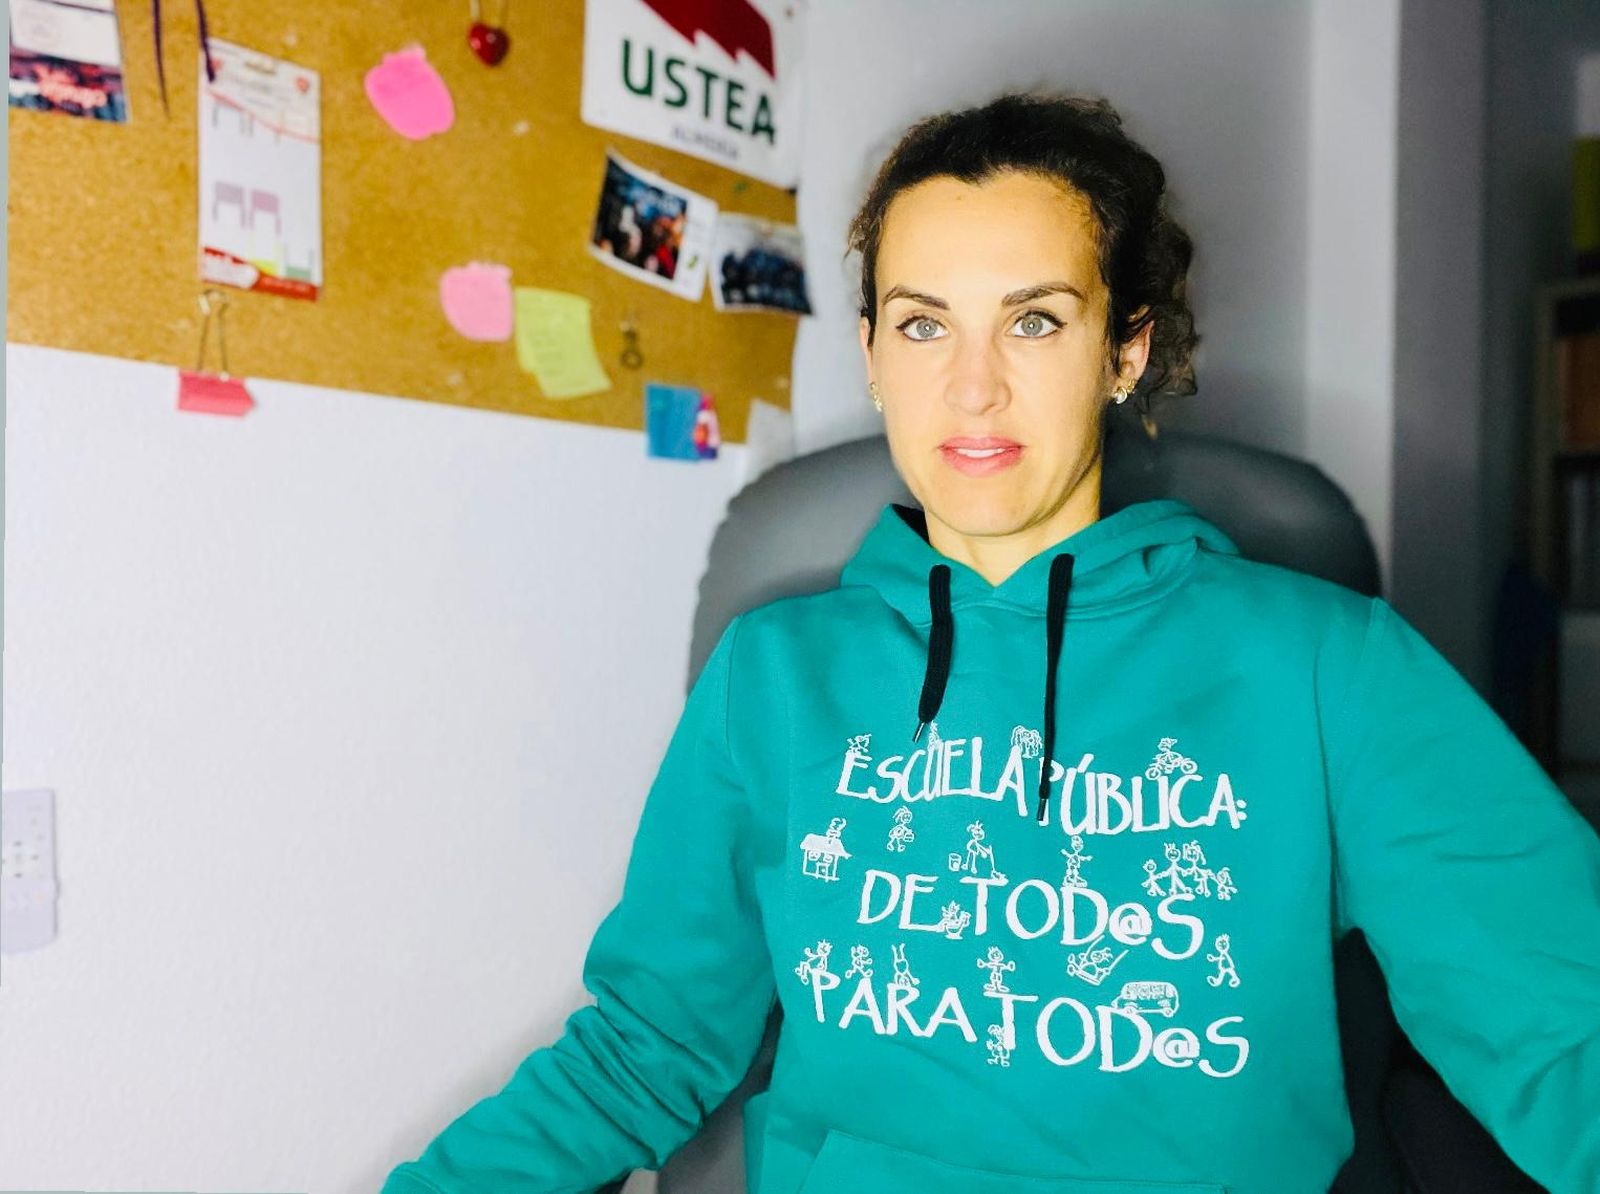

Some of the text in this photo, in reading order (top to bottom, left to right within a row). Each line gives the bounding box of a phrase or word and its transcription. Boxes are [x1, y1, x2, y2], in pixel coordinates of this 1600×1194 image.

[622, 38, 776, 146] USTEA
[836, 735, 1028, 817] ESCUELA
[857, 868, 1205, 960] DE TOD@S
[810, 968, 1249, 1078] PARA TOD@S
